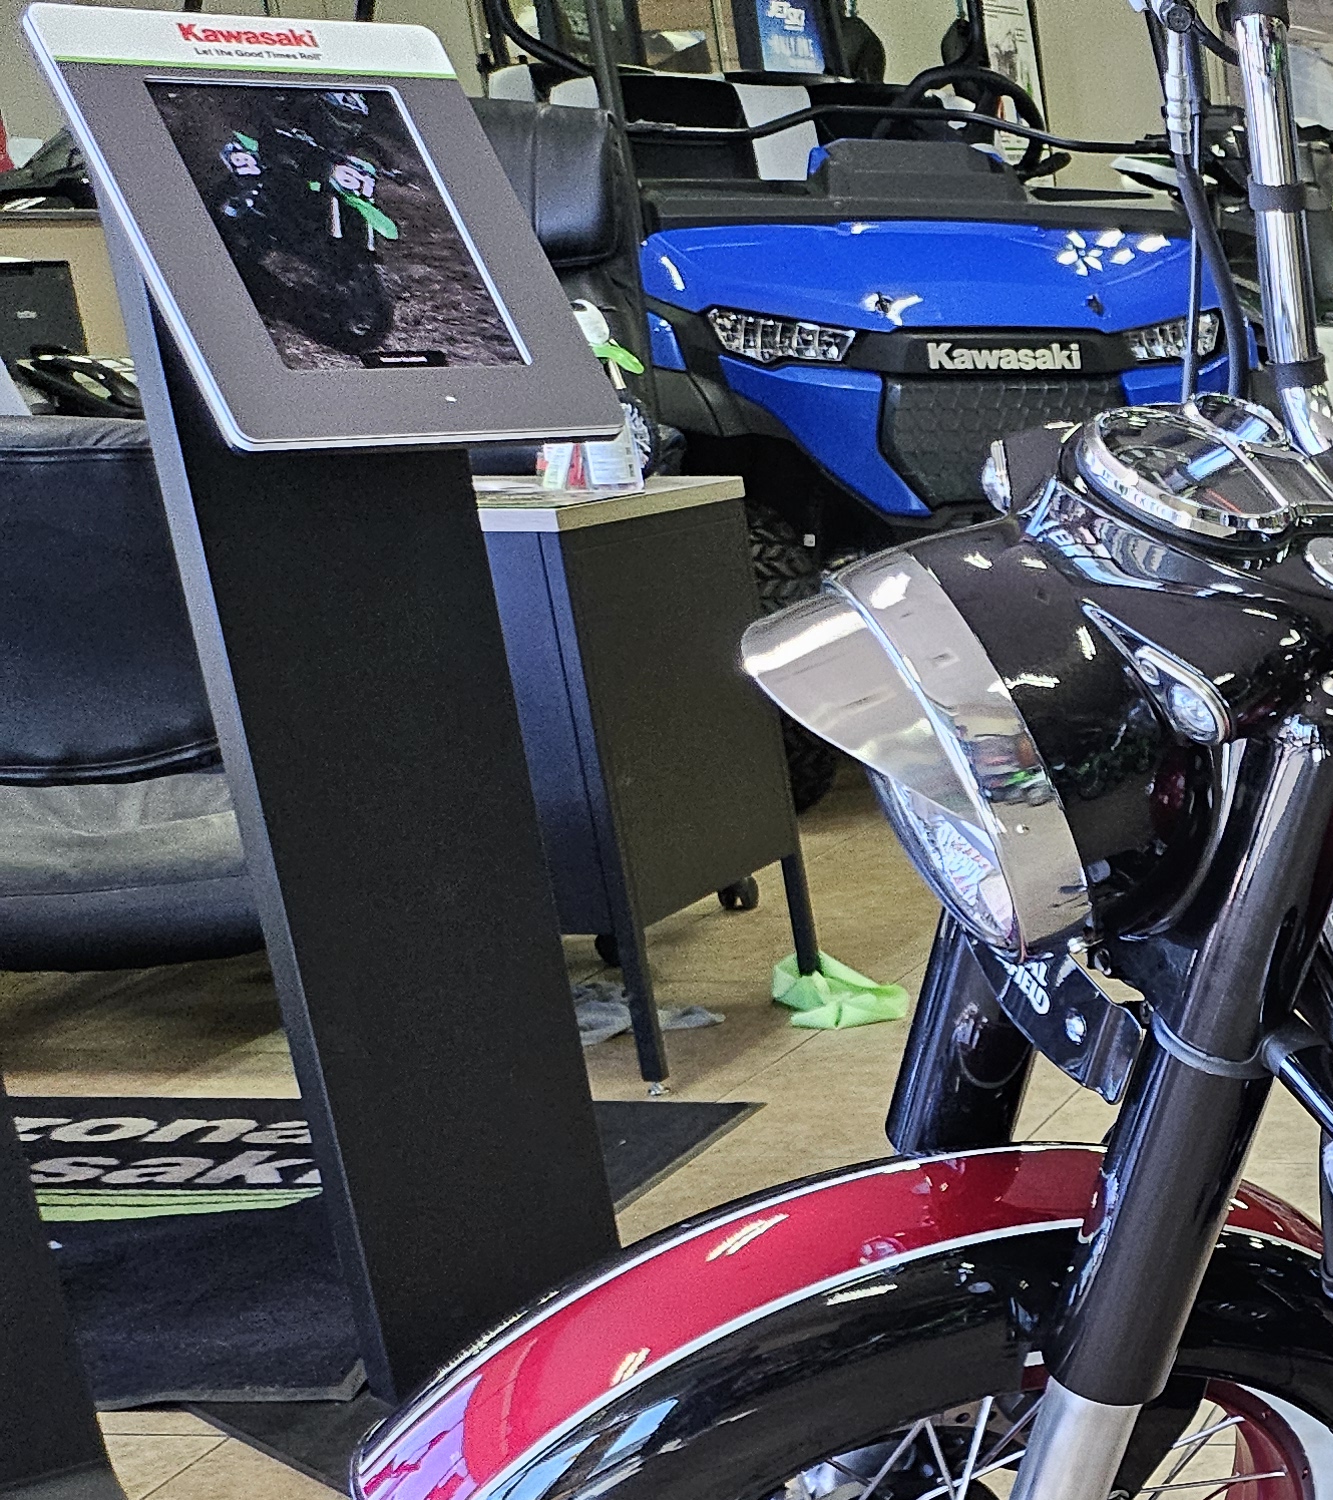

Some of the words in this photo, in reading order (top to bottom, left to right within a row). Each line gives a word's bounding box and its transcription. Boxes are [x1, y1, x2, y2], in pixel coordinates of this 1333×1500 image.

[176, 23, 319, 48] Kawasaki
[194, 47, 213, 56] Let
[214, 48, 233, 57] the
[235, 49, 264, 58] Good
[266, 50, 297, 60] Times
[927, 342, 1082, 370] Kawasaki
